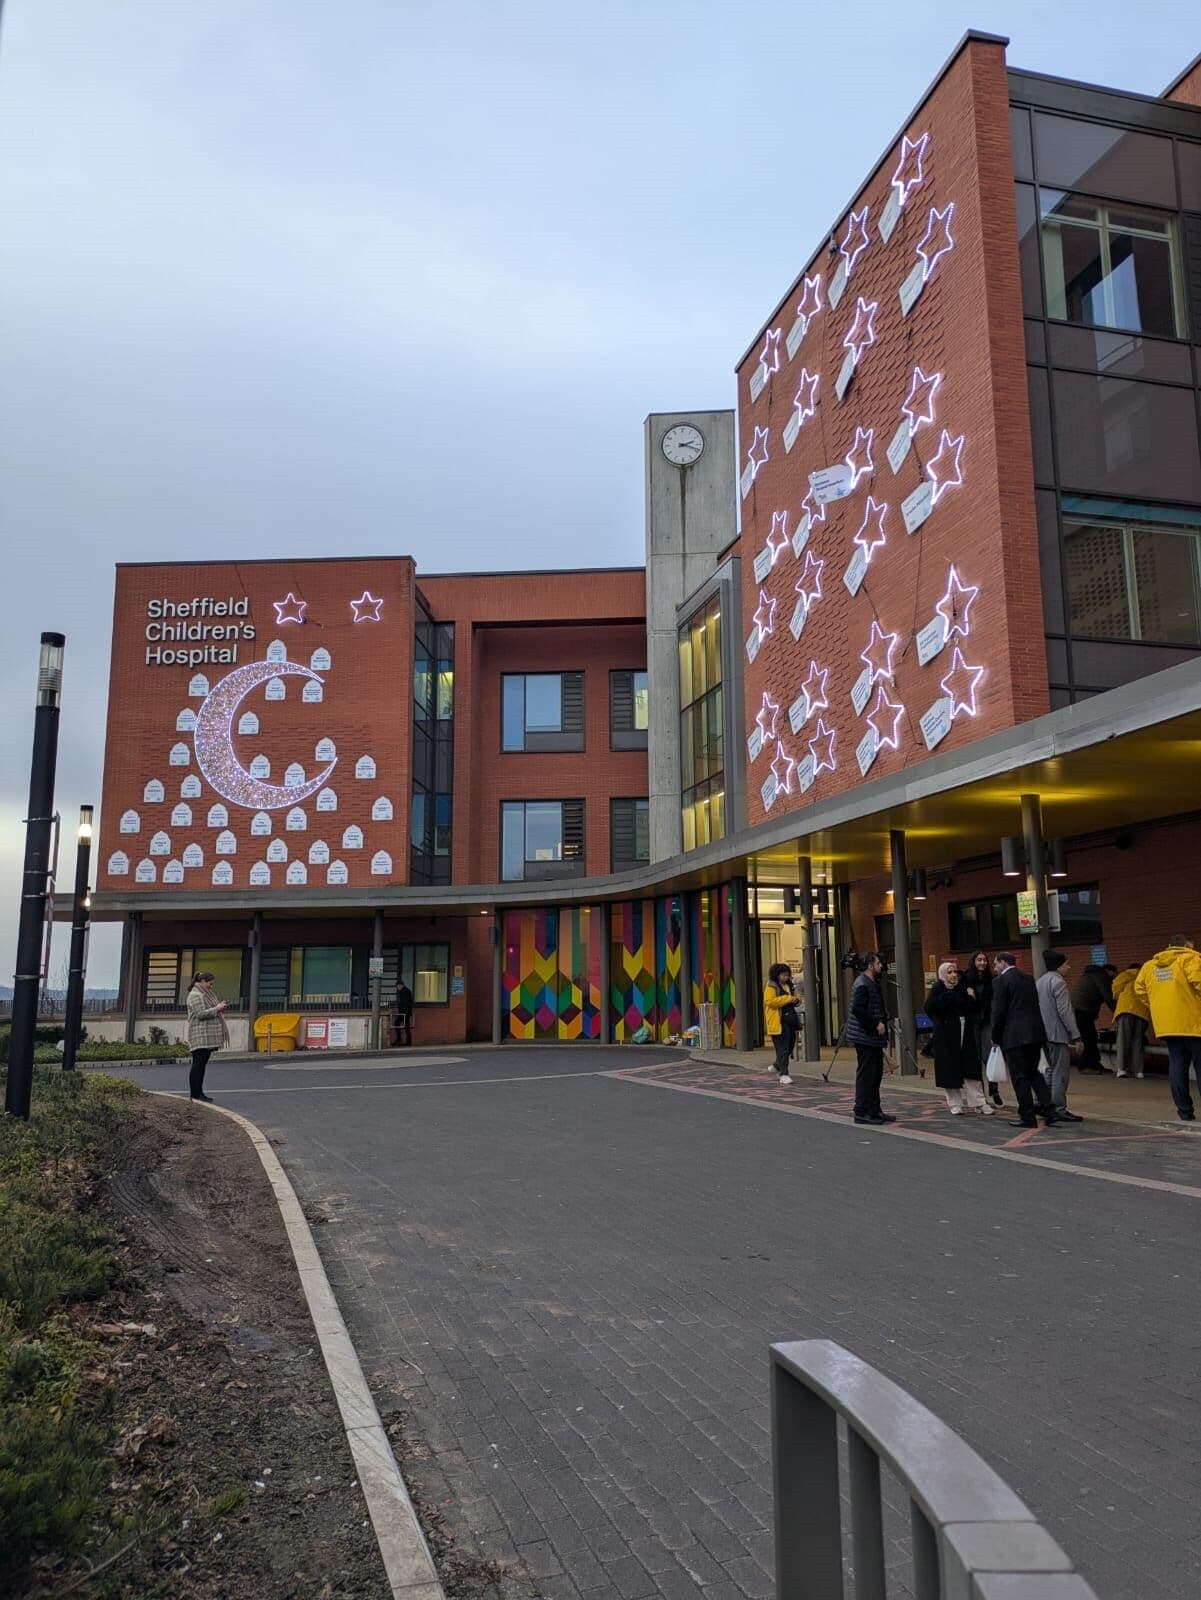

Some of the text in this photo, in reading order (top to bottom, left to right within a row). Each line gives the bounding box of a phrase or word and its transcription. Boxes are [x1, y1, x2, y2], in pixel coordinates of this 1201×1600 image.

[147, 597, 249, 618] Sheffield
[145, 621, 256, 642] Children's
[145, 643, 238, 668] Hospital
